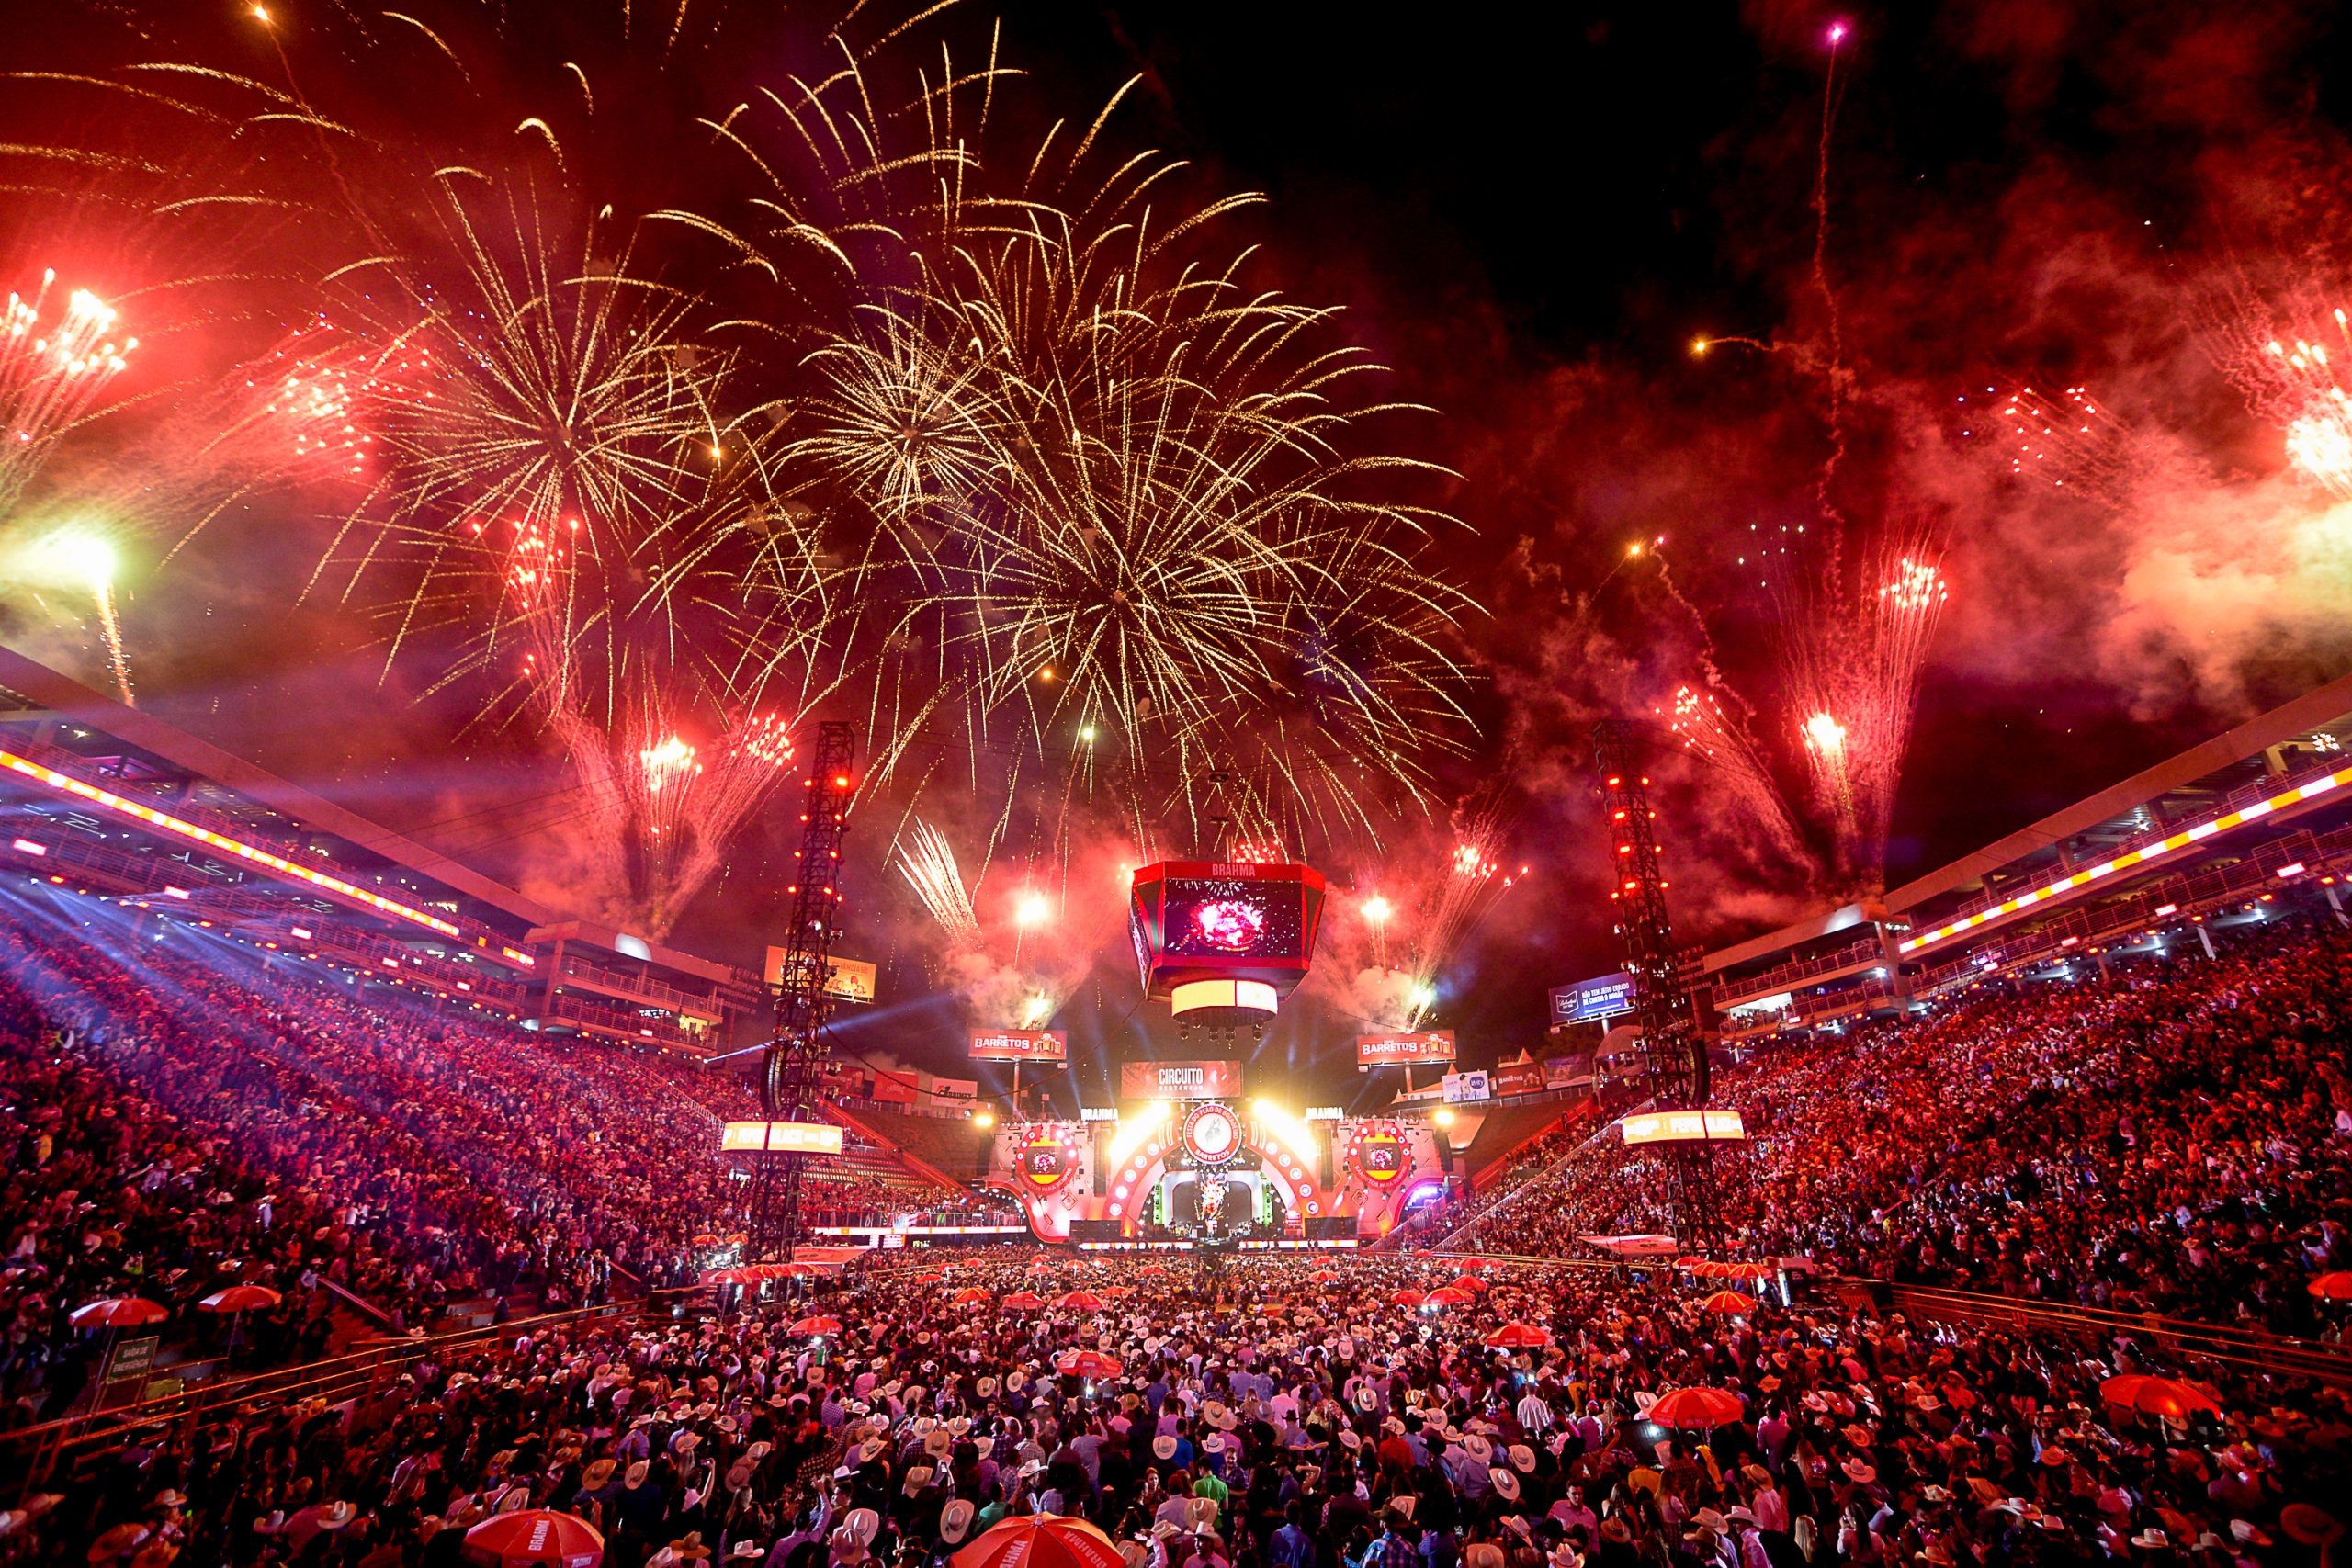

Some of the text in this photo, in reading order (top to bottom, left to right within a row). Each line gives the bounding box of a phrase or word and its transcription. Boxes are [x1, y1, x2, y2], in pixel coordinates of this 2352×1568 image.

[1212, 863, 1256, 876] BRAHMA
[974, 1037, 1030, 1049] BARRETOS
[1362, 1042, 1418, 1055] BARRETOS
[1159, 1068, 1204, 1085] CIRCUITO
[1080, 1108, 1118, 1121] BRAHMA
[1192, 1112, 1200, 1122] DO
[1214, 1106, 1223, 1114] DE
[1306, 1106, 1344, 1120] BRAHMA
[1194, 1149, 1230, 1161] BARRETOS
[528, 1519, 551, 1551] BRAHMA
[999, 1540, 1029, 1568] AHMA
[1063, 1530, 1108, 1568] BRAHMA
